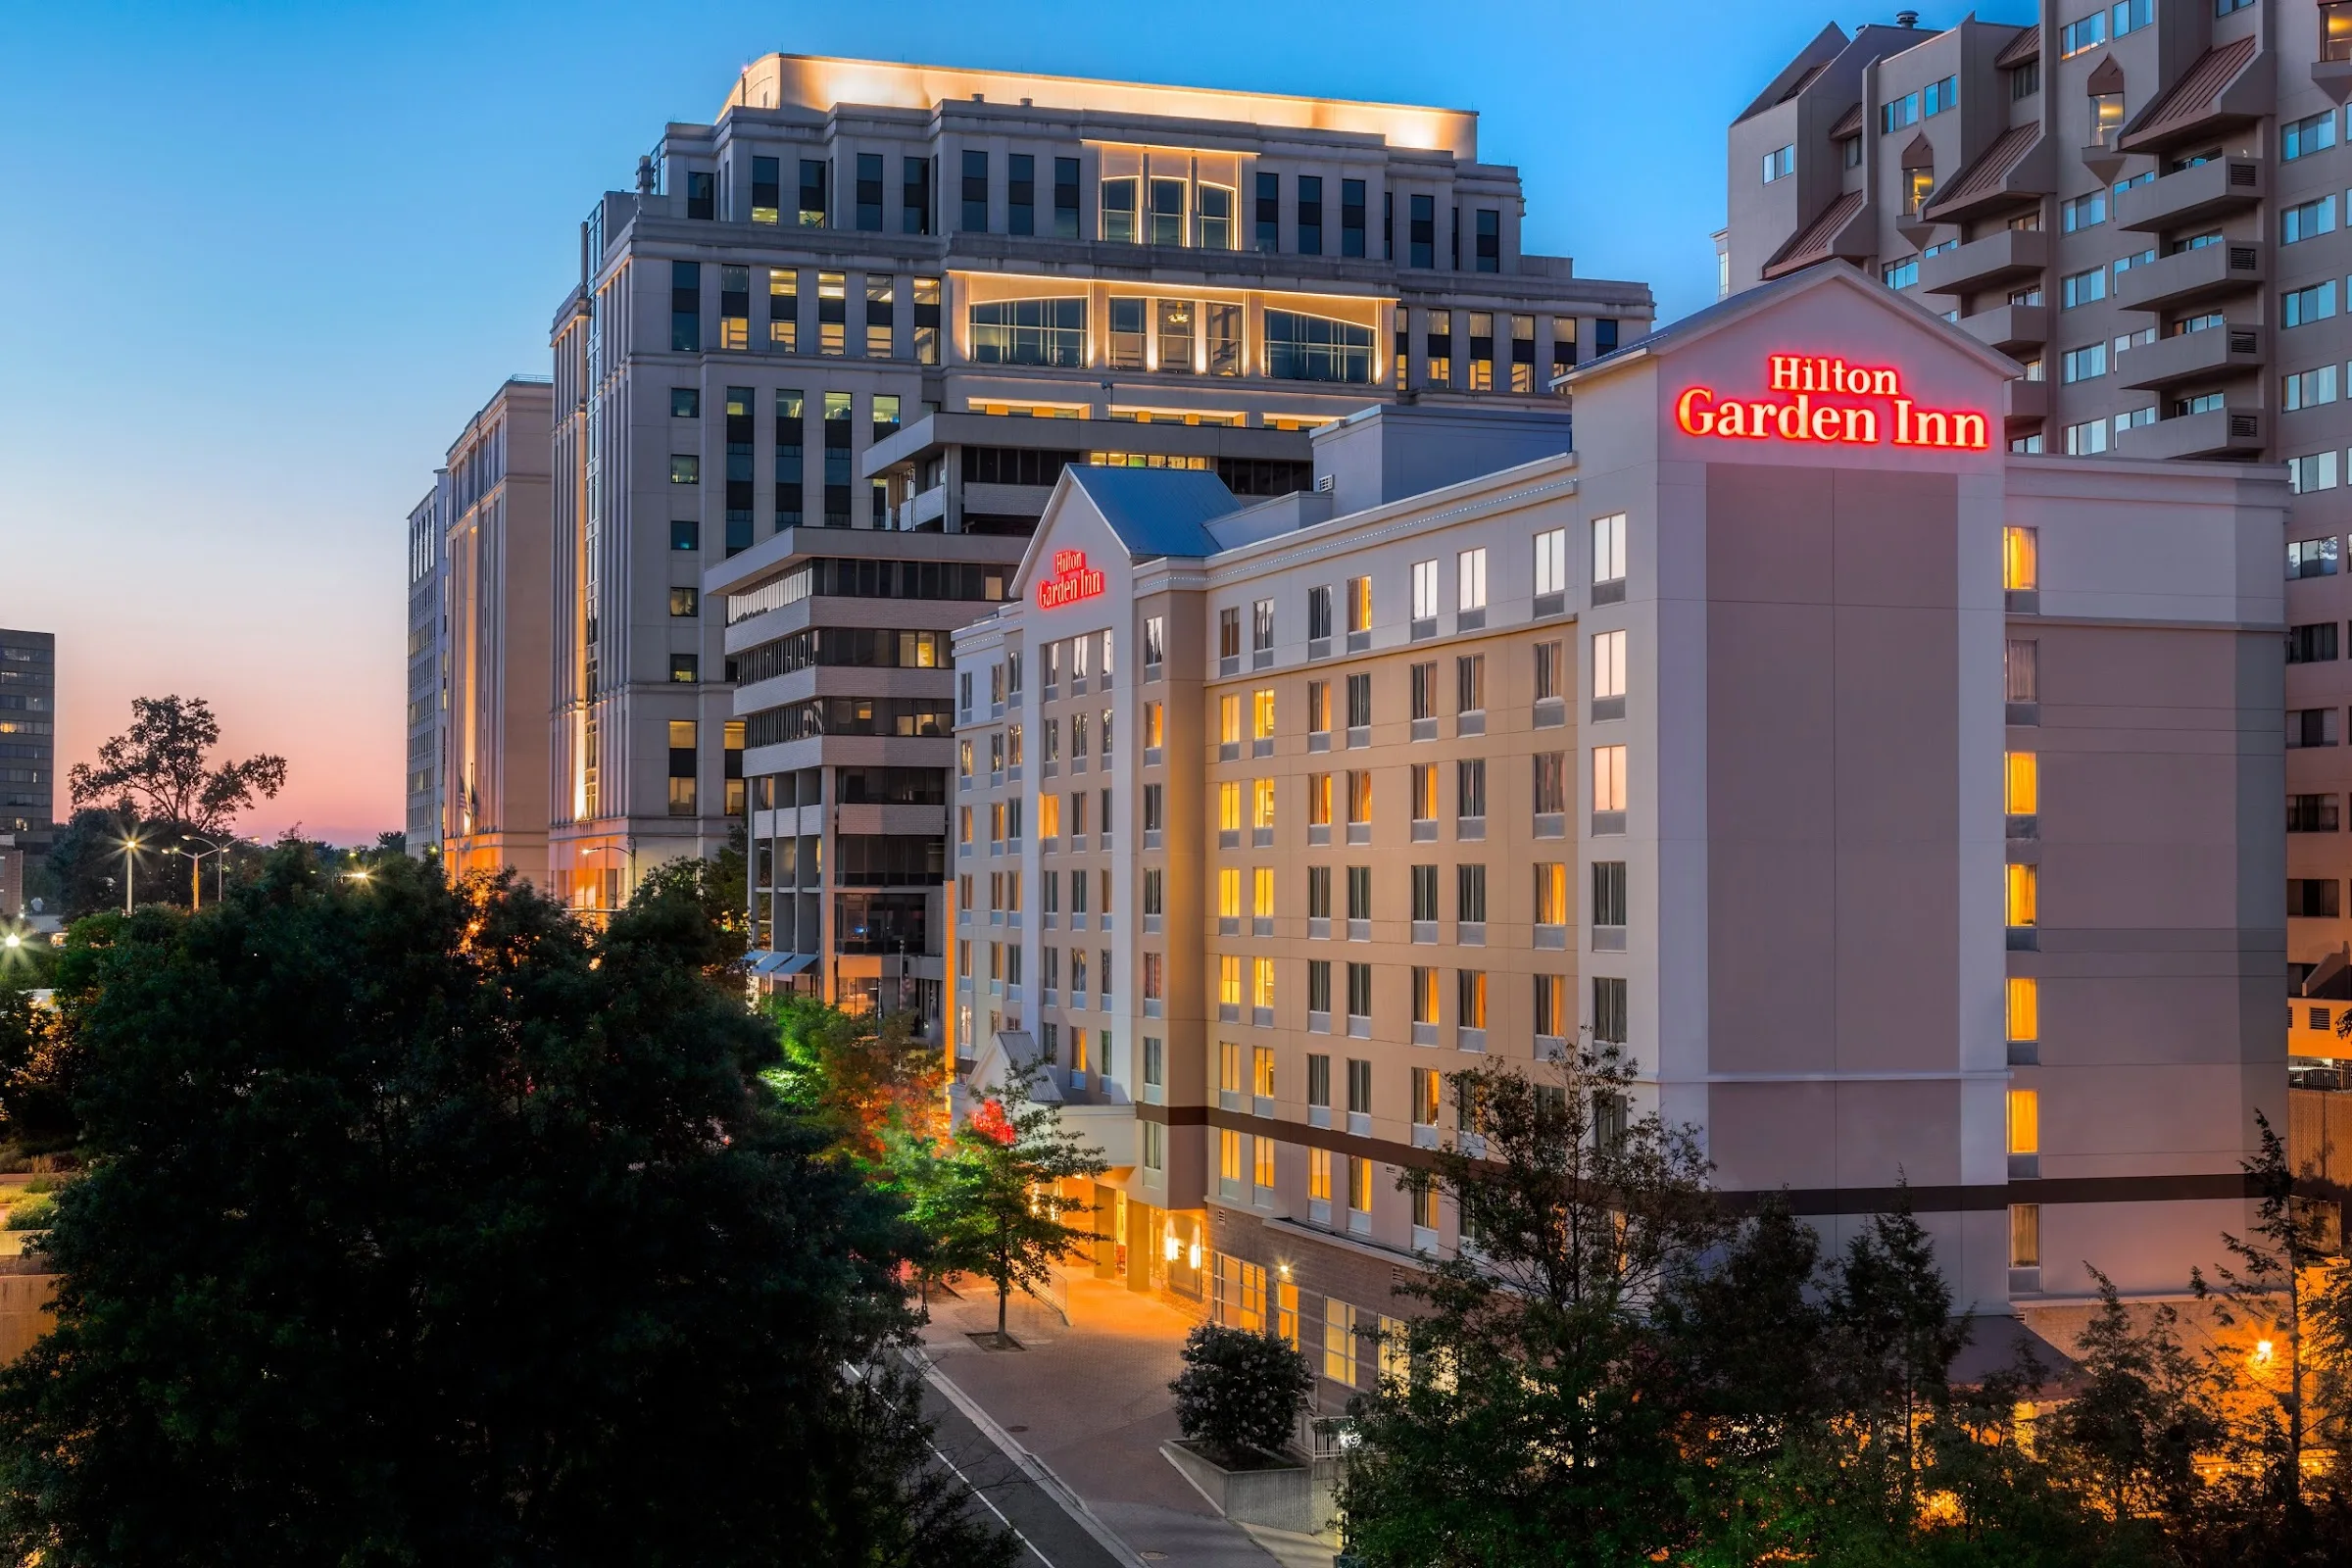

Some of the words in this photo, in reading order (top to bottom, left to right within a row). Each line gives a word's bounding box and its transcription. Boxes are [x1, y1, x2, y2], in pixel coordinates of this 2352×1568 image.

[1770, 356, 1899, 395] Hilton
[1679, 388, 1879, 442] Garden
[1893, 399, 1988, 448] Inn
[1055, 551, 1082, 574] Hilton
[1039, 575, 1077, 609] Garden
[1080, 568, 1101, 597] Inn
